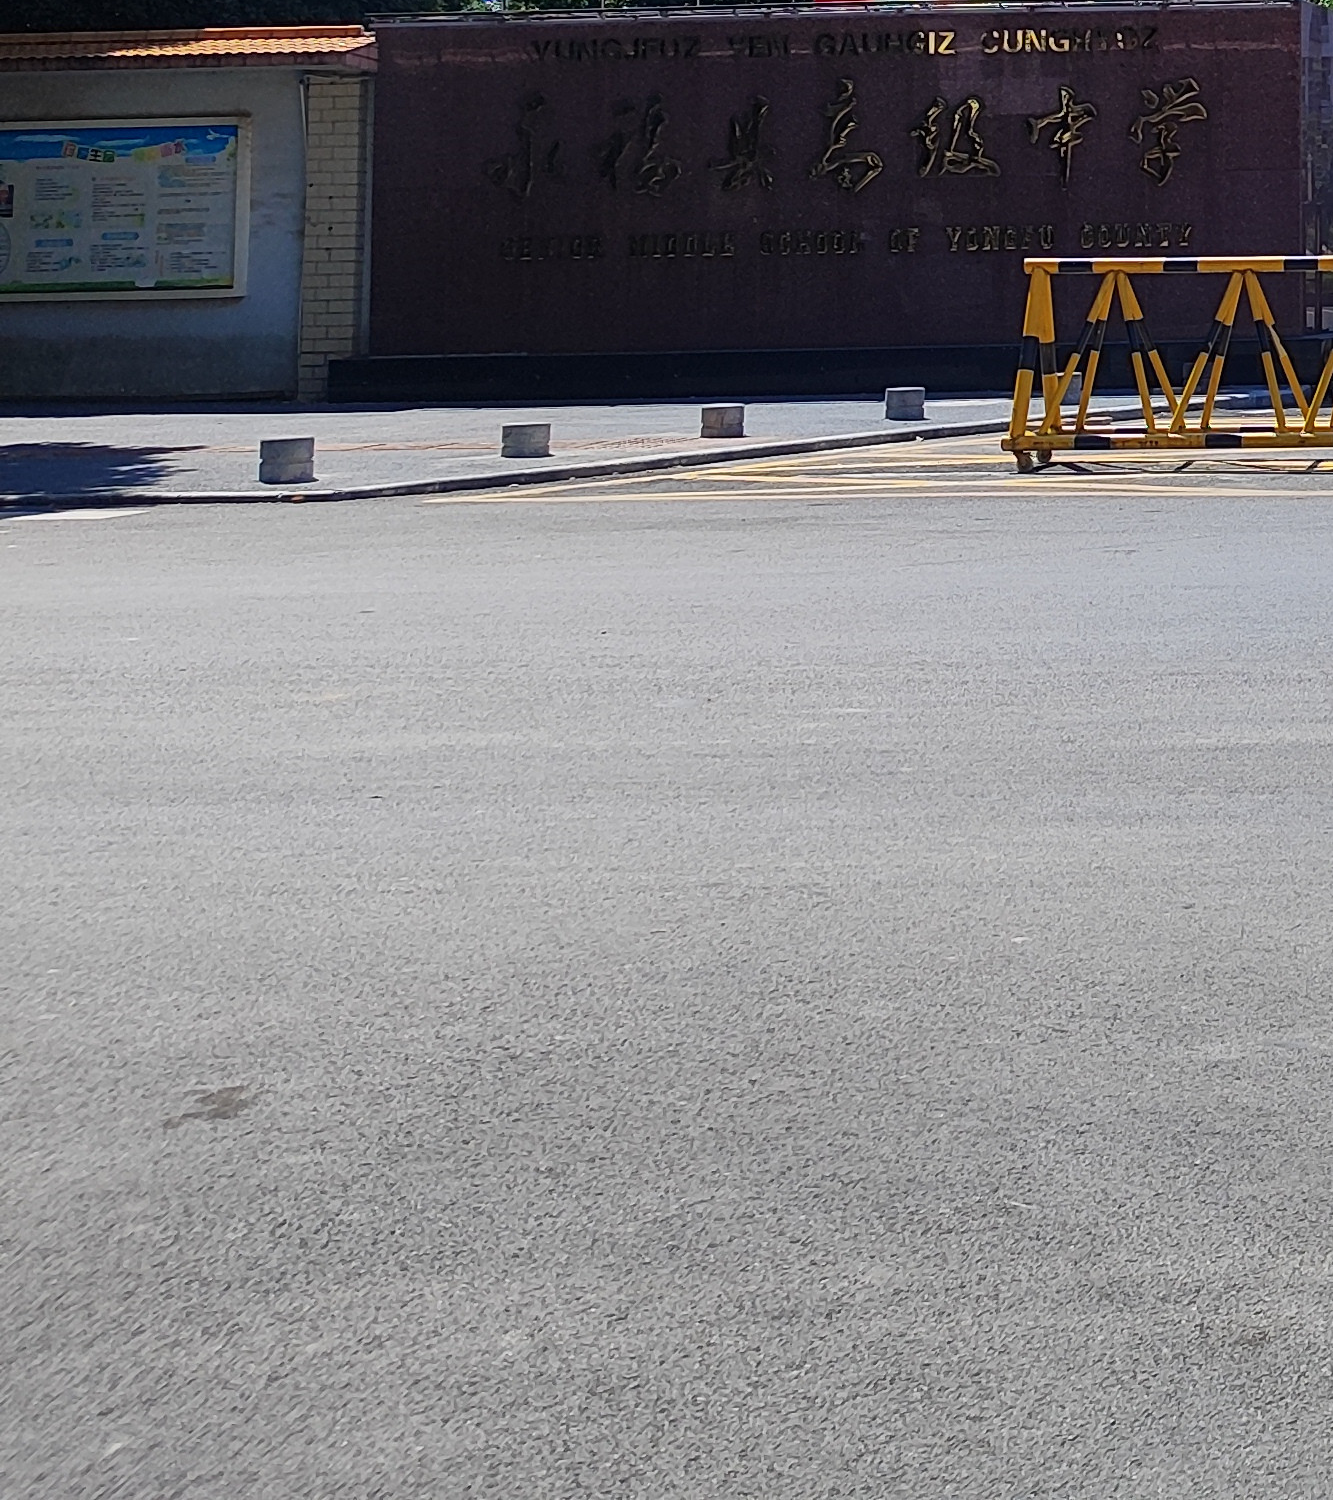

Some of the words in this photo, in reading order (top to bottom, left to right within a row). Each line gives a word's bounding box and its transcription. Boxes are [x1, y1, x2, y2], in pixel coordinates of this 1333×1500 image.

[484, 77, 1209, 197] 永福县高级中学
[889, 226, 921, 254] OF
[945, 223, 1056, 252] YONGFU
[1080, 221, 1192, 249] COUNTY
